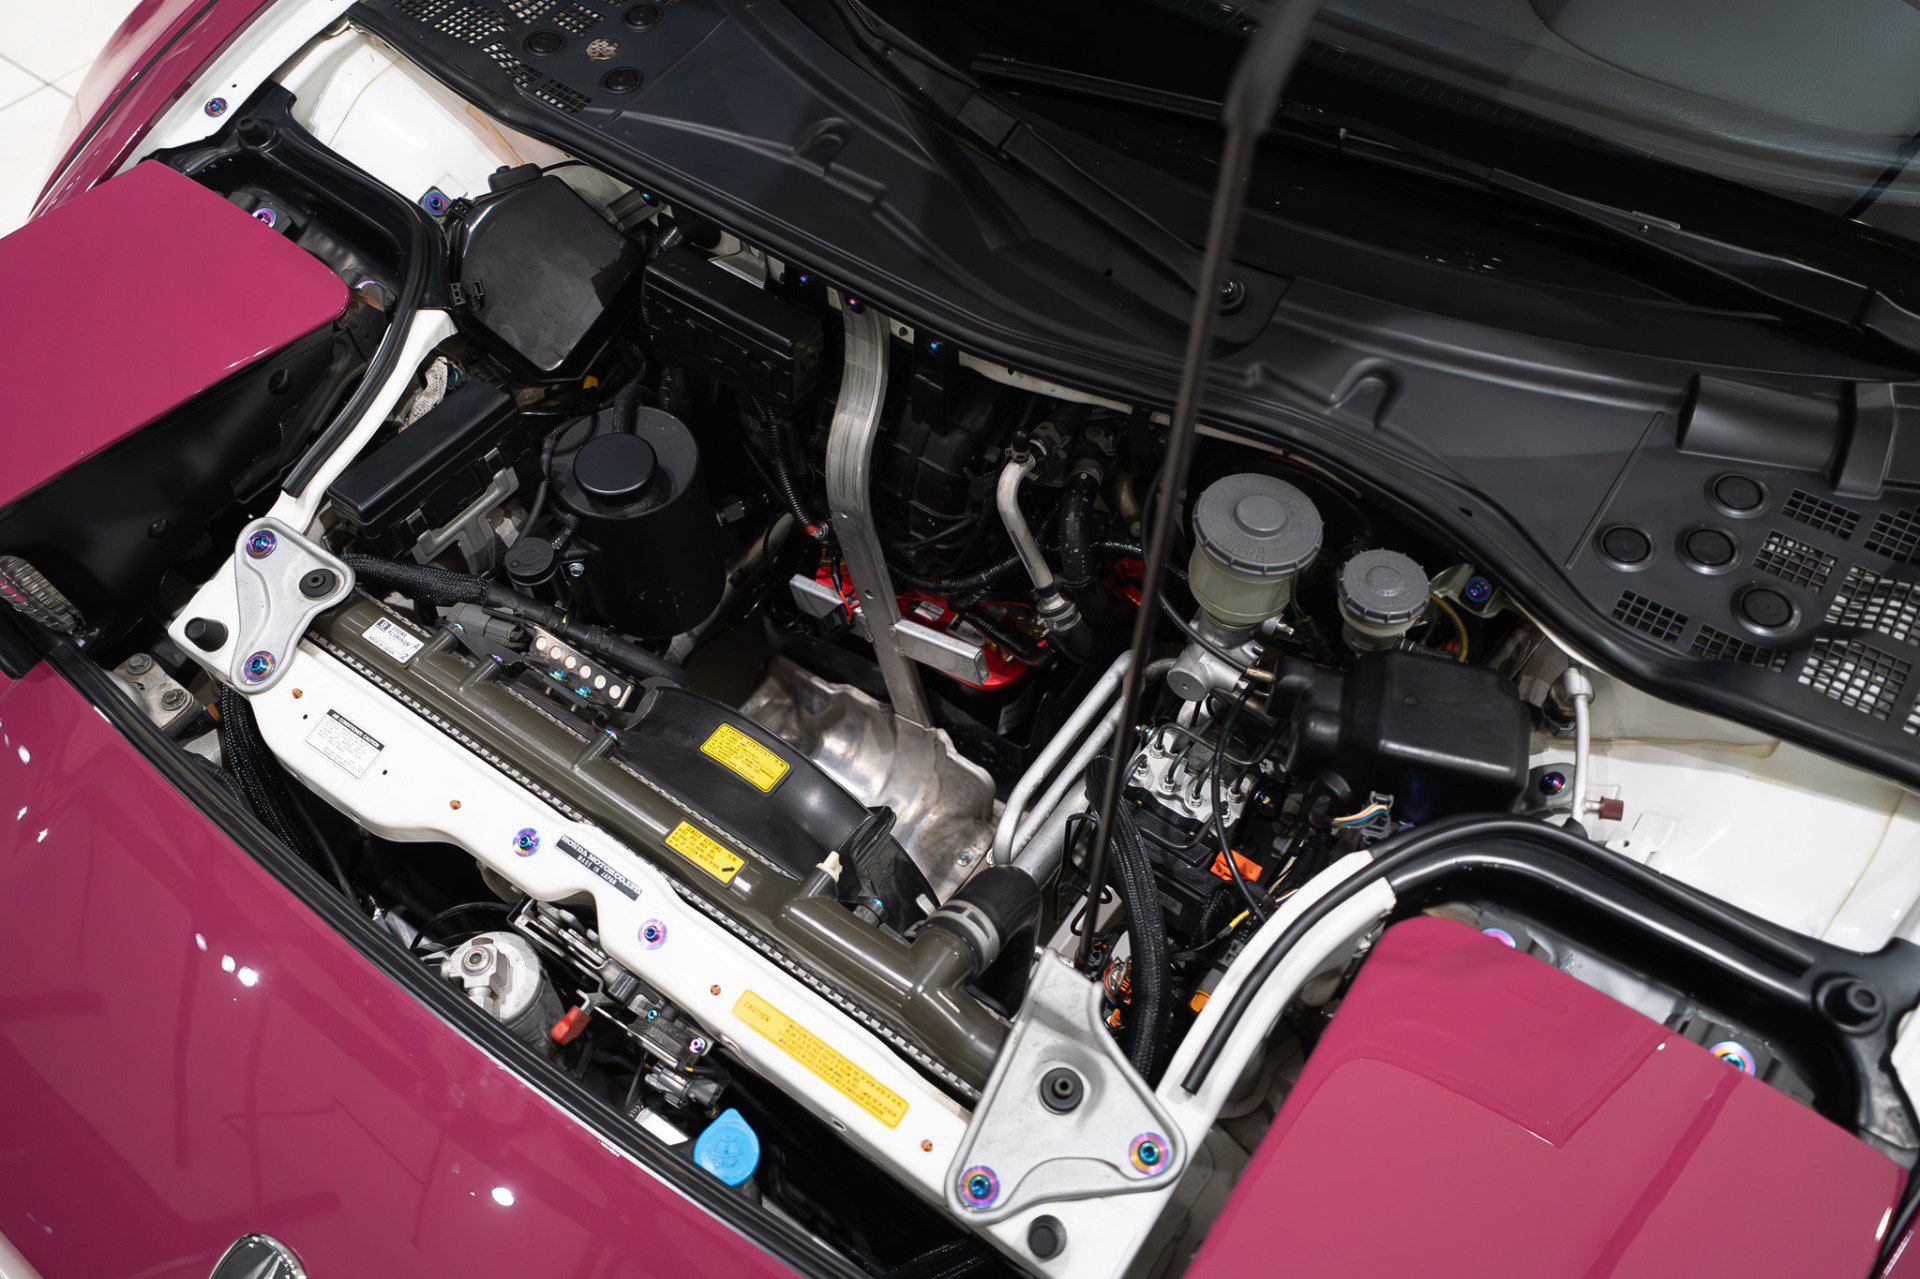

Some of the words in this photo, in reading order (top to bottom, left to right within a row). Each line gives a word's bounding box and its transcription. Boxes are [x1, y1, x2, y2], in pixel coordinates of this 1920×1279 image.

[560, 835, 589, 857] HONDA
[586, 853, 615, 875] MOTOR
[576, 854, 593, 868] MADE
[591, 865, 601, 873] IN
[599, 871, 618, 885] JAPAN
[743, 1001, 770, 1023] CAUTION
